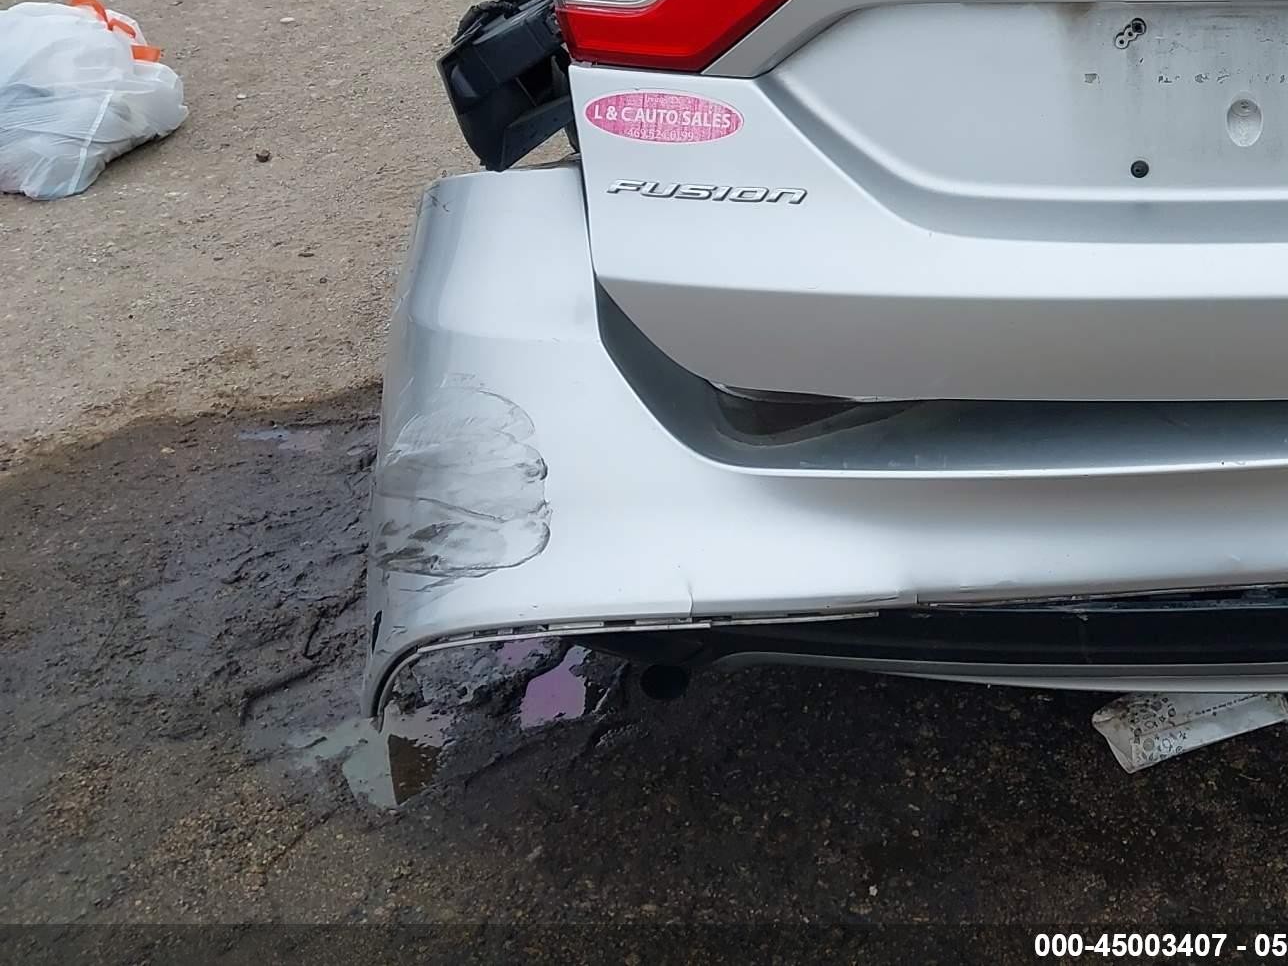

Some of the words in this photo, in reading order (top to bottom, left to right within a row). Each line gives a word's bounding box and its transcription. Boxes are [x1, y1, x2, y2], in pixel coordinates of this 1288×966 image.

[594, 105, 602, 120] L
[606, 106, 618, 121] &
[635, 109, 678, 125] AUTO
[681, 111, 731, 128] SALES
[607, 179, 807, 204] FUSION
